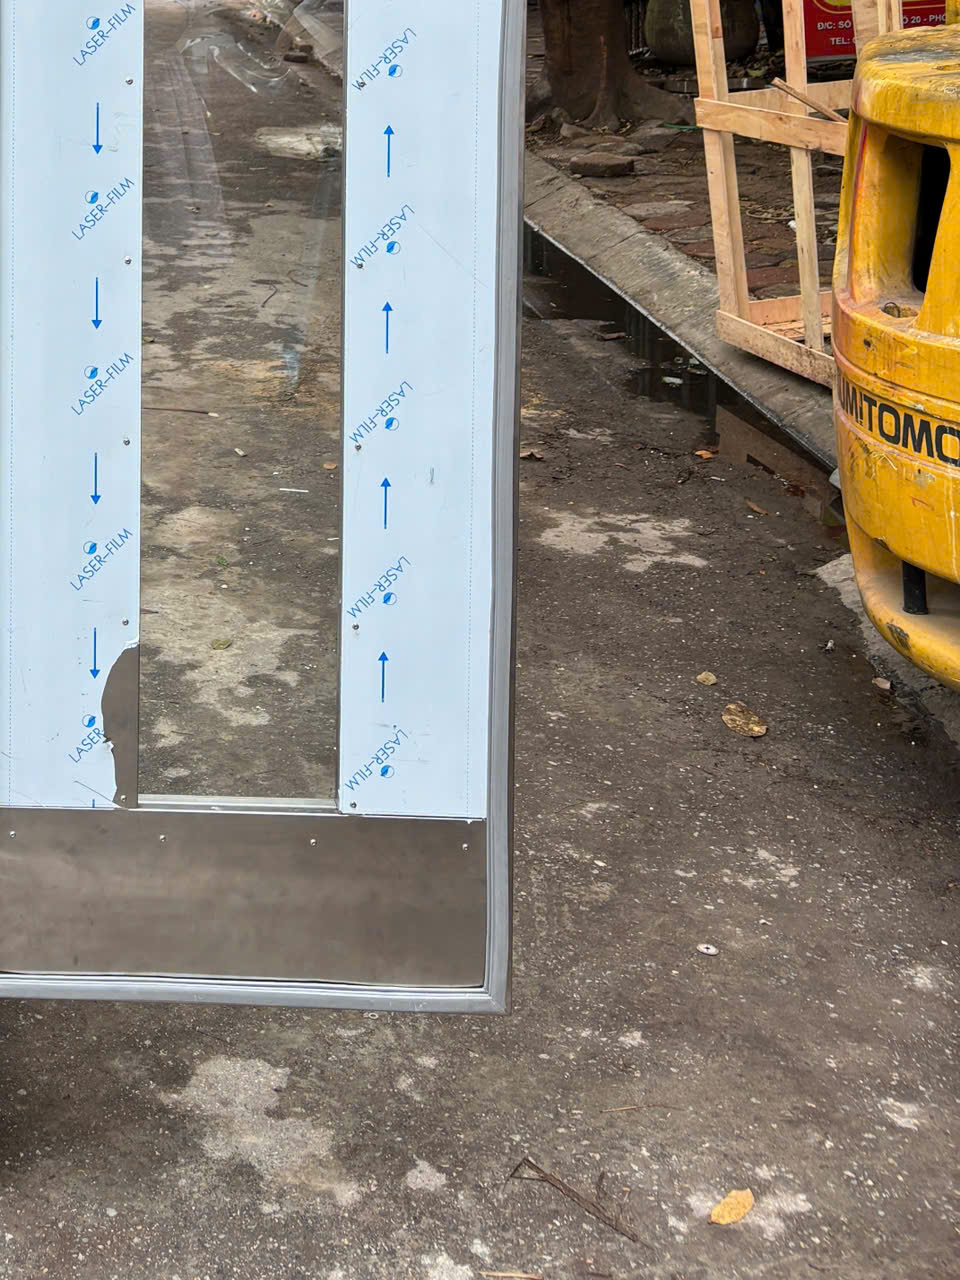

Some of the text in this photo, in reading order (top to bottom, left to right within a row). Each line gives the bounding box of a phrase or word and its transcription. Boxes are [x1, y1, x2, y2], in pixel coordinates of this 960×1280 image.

[73, 3, 136, 66] LASER-FILM
[352, 27, 417, 91] LASER-FILM
[71, 177, 135, 241] LASER-FILM
[350, 204, 415, 267] LASER-FILM
[71, 352, 134, 416] LASER-FILM
[349, 380, 413, 445] LASER-FILM
[70, 527, 133, 592] LASER-FILM
[346, 555, 411, 619] LASER-FILM
[344, 728, 409, 792] LASER-FILM
